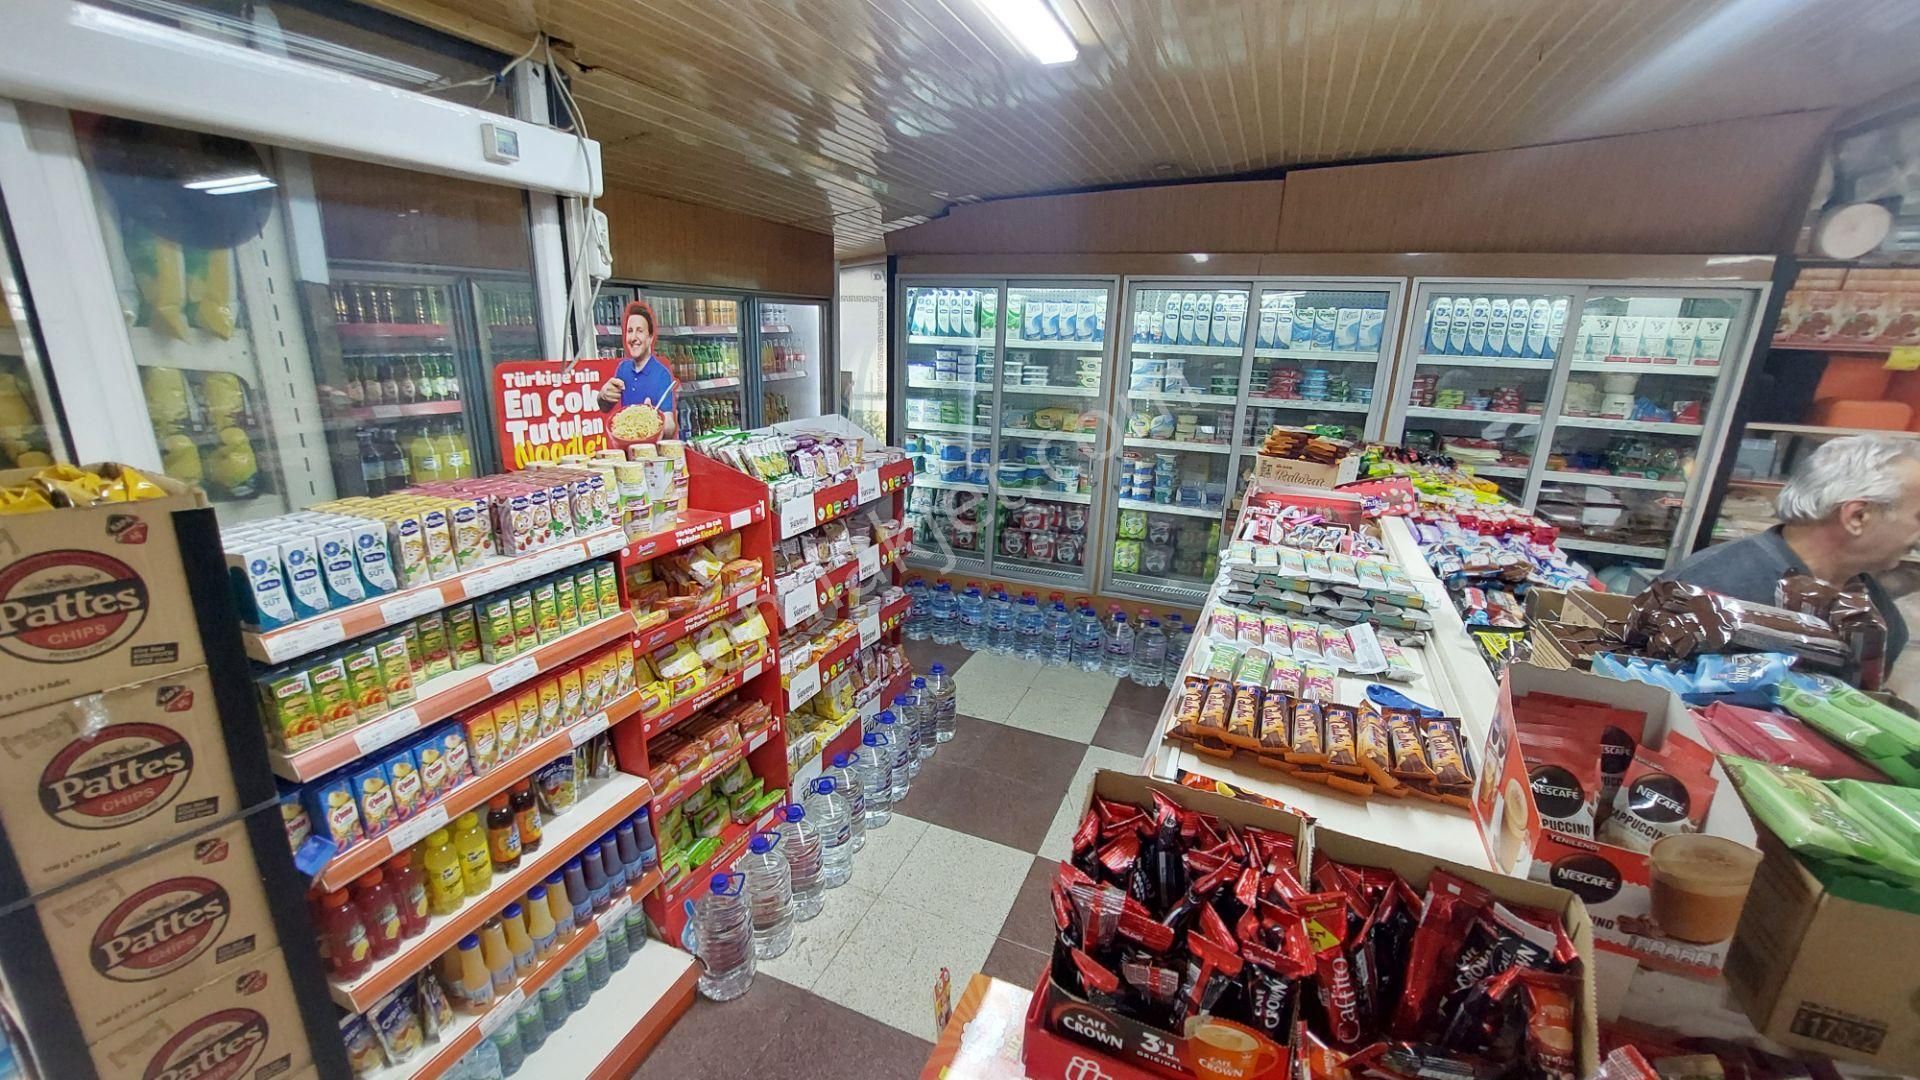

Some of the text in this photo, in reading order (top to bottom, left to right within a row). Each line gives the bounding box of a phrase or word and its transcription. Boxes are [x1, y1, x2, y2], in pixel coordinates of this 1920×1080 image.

[502, 368, 601, 389] Türkiye'nin
[504, 384, 600, 419] En Çok
[505, 415, 604, 448] Tutulan
[0, 586, 140, 634] Pattes
[48, 624, 107, 645] CHIPS
[278, 681, 304, 696] TAMEK
[316, 668, 340, 682] TAMEK
[50, 752, 187, 810] Pattes
[102, 786, 156, 812] CHIPS
[100, 898, 225, 968] Pattes
[148, 933, 198, 964] CHIPS
[1332, 956, 1361, 1044] Caffito
[1063, 1017, 1123, 1050] CROWN
[1077, 1014, 1107, 1031] CAFE
[1198, 1058, 1244, 1078] CROWN
